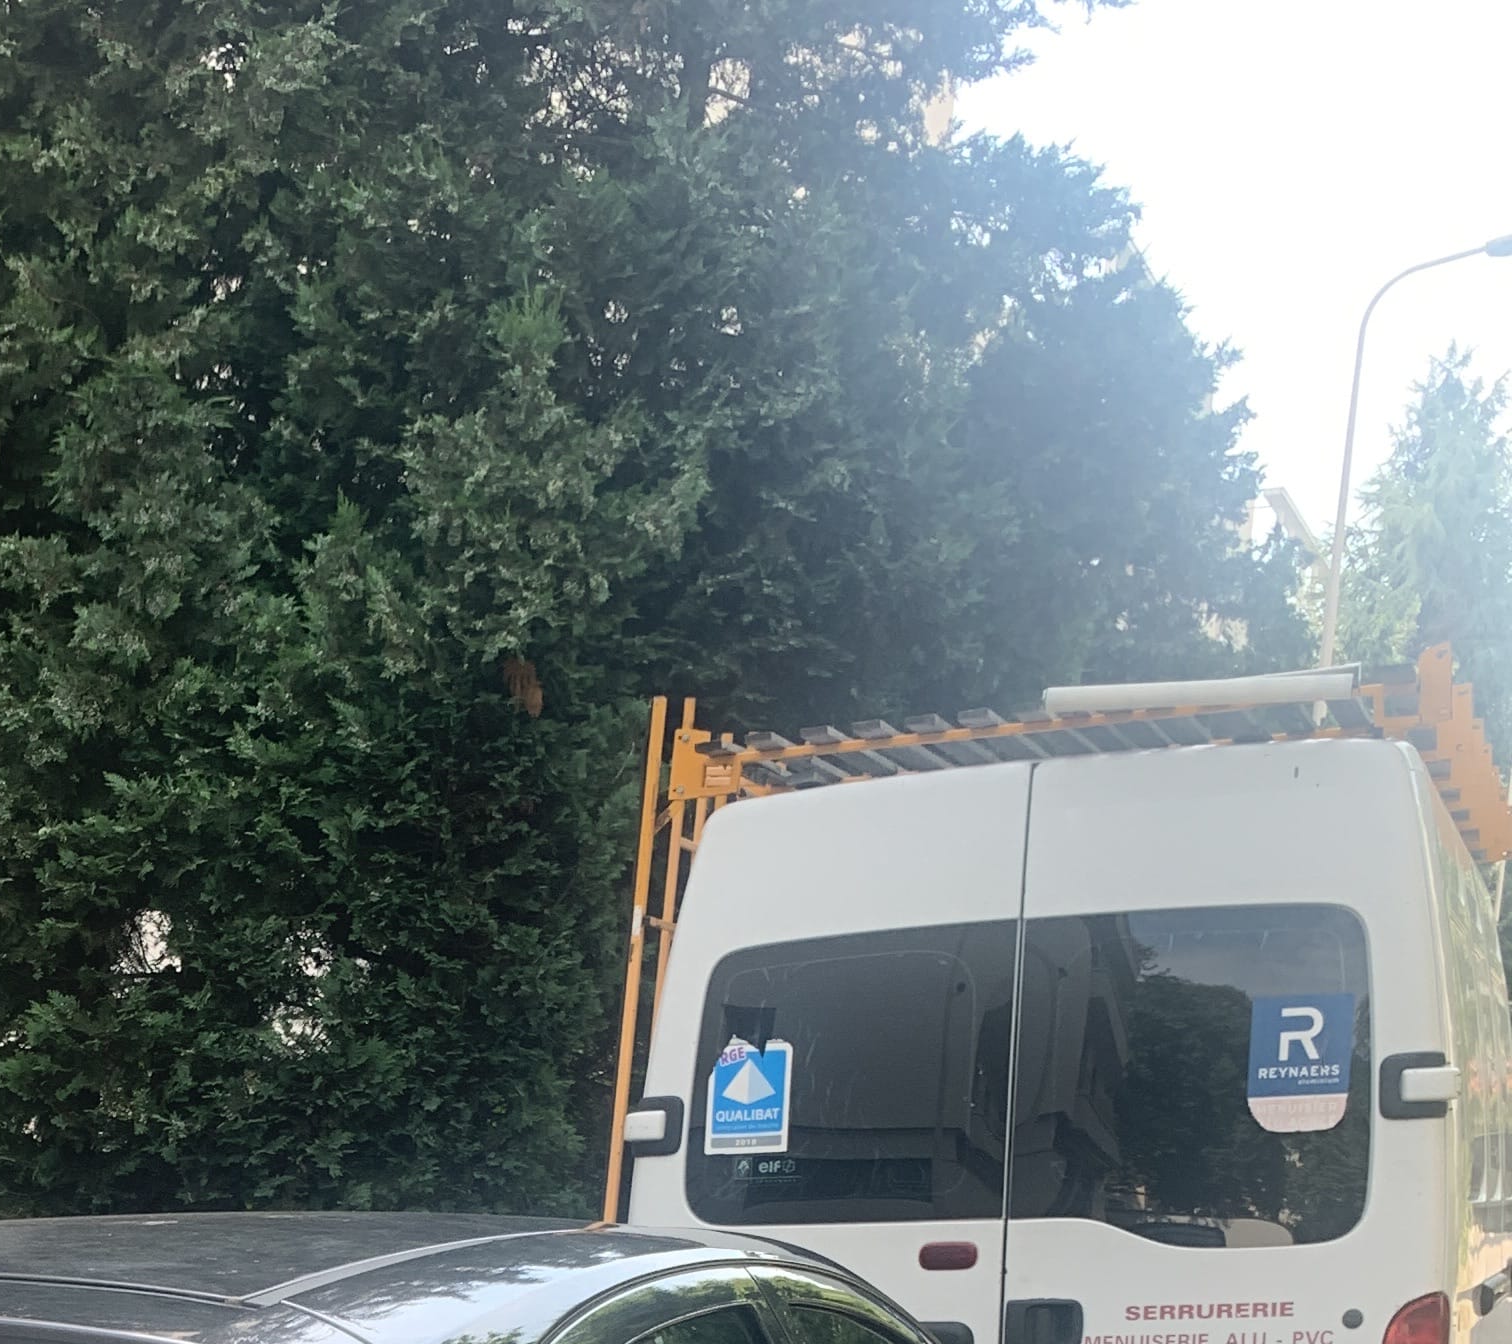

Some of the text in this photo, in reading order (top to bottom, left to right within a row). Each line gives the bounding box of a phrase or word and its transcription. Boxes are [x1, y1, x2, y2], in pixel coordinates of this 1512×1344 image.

[1278, 1006, 1324, 1061] R
[720, 1047, 746, 1065] RGE
[1257, 1064, 1340, 1080] REYNAERS
[715, 1107, 781, 1124] QUALIBAT
[757, 1160, 782, 1174] elf
[1125, 1301, 1295, 1321] SERRURERIE
